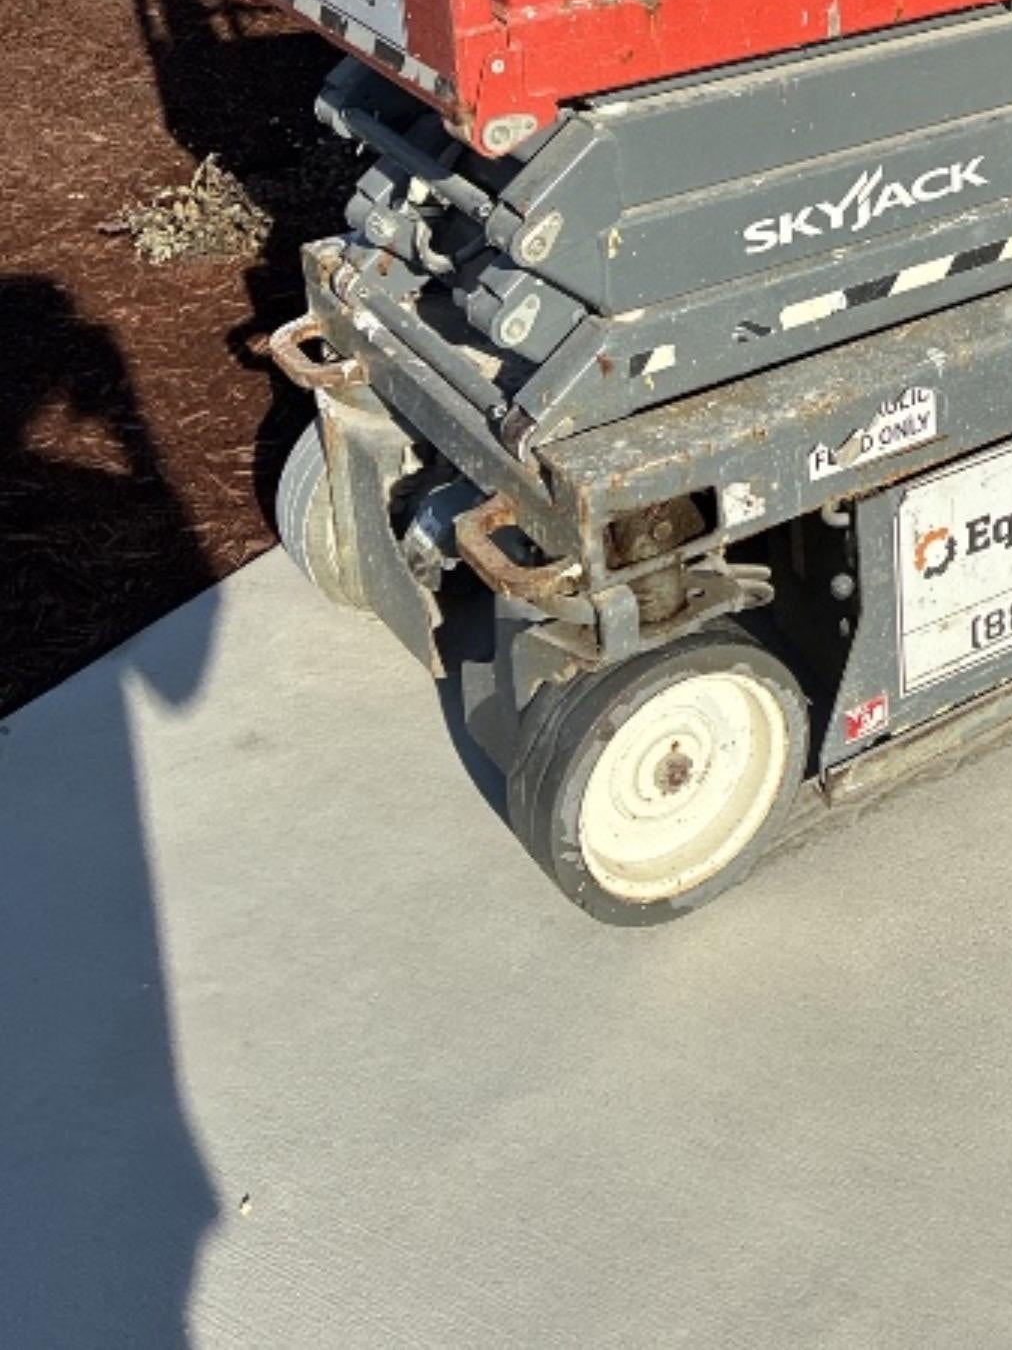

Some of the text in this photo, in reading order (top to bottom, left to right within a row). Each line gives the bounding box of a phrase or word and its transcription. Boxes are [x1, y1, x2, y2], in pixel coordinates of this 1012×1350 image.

[743, 155, 990, 255] SKYJACK
[814, 410, 932, 472] FLD ONLY
